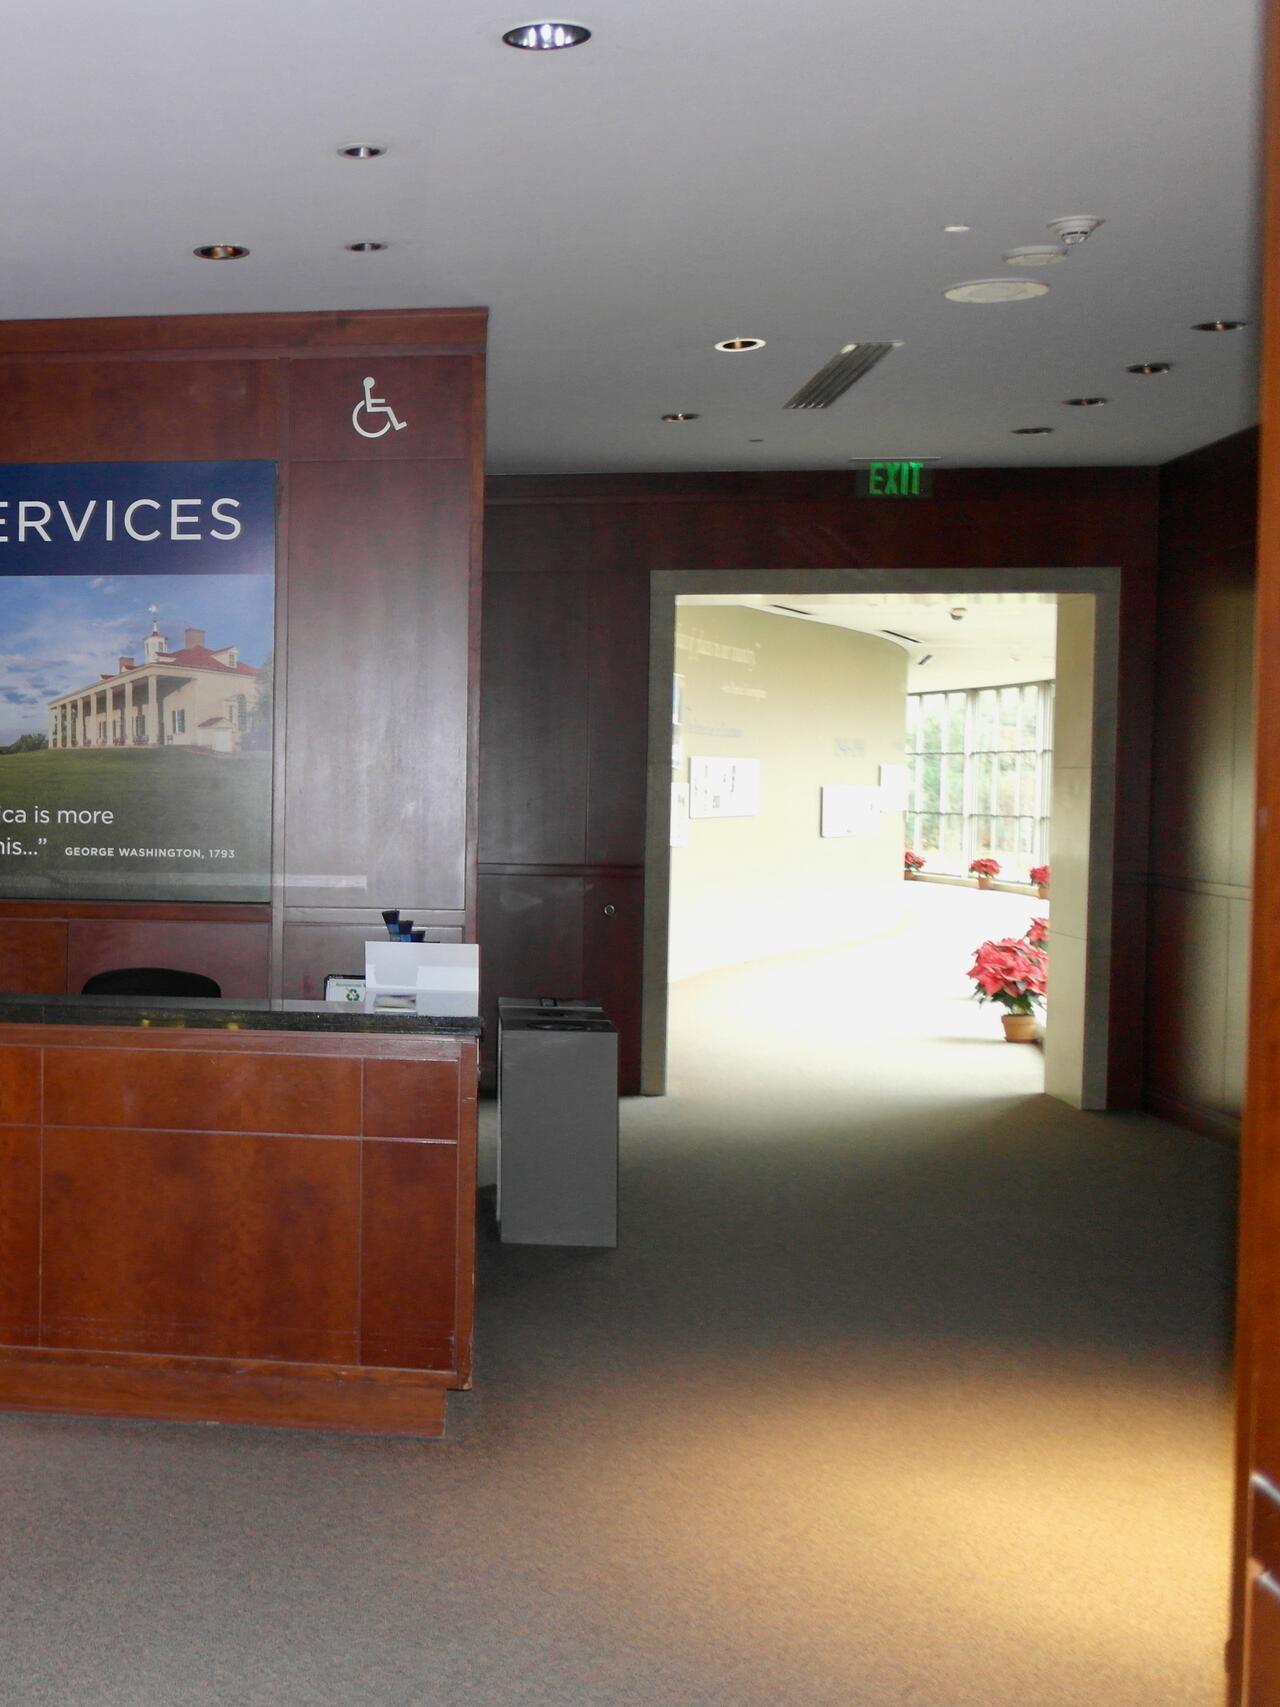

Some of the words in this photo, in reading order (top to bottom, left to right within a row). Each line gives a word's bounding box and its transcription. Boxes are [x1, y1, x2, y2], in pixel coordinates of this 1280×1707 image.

[868, 461, 924, 496] EXIT
[33, 805, 51, 825] is
[56, 809, 115, 825] more
[64, 846, 115, 857] GEORGE
[118, 846, 205, 860] WASHINGTON,
[208, 848, 236, 859] 1793
